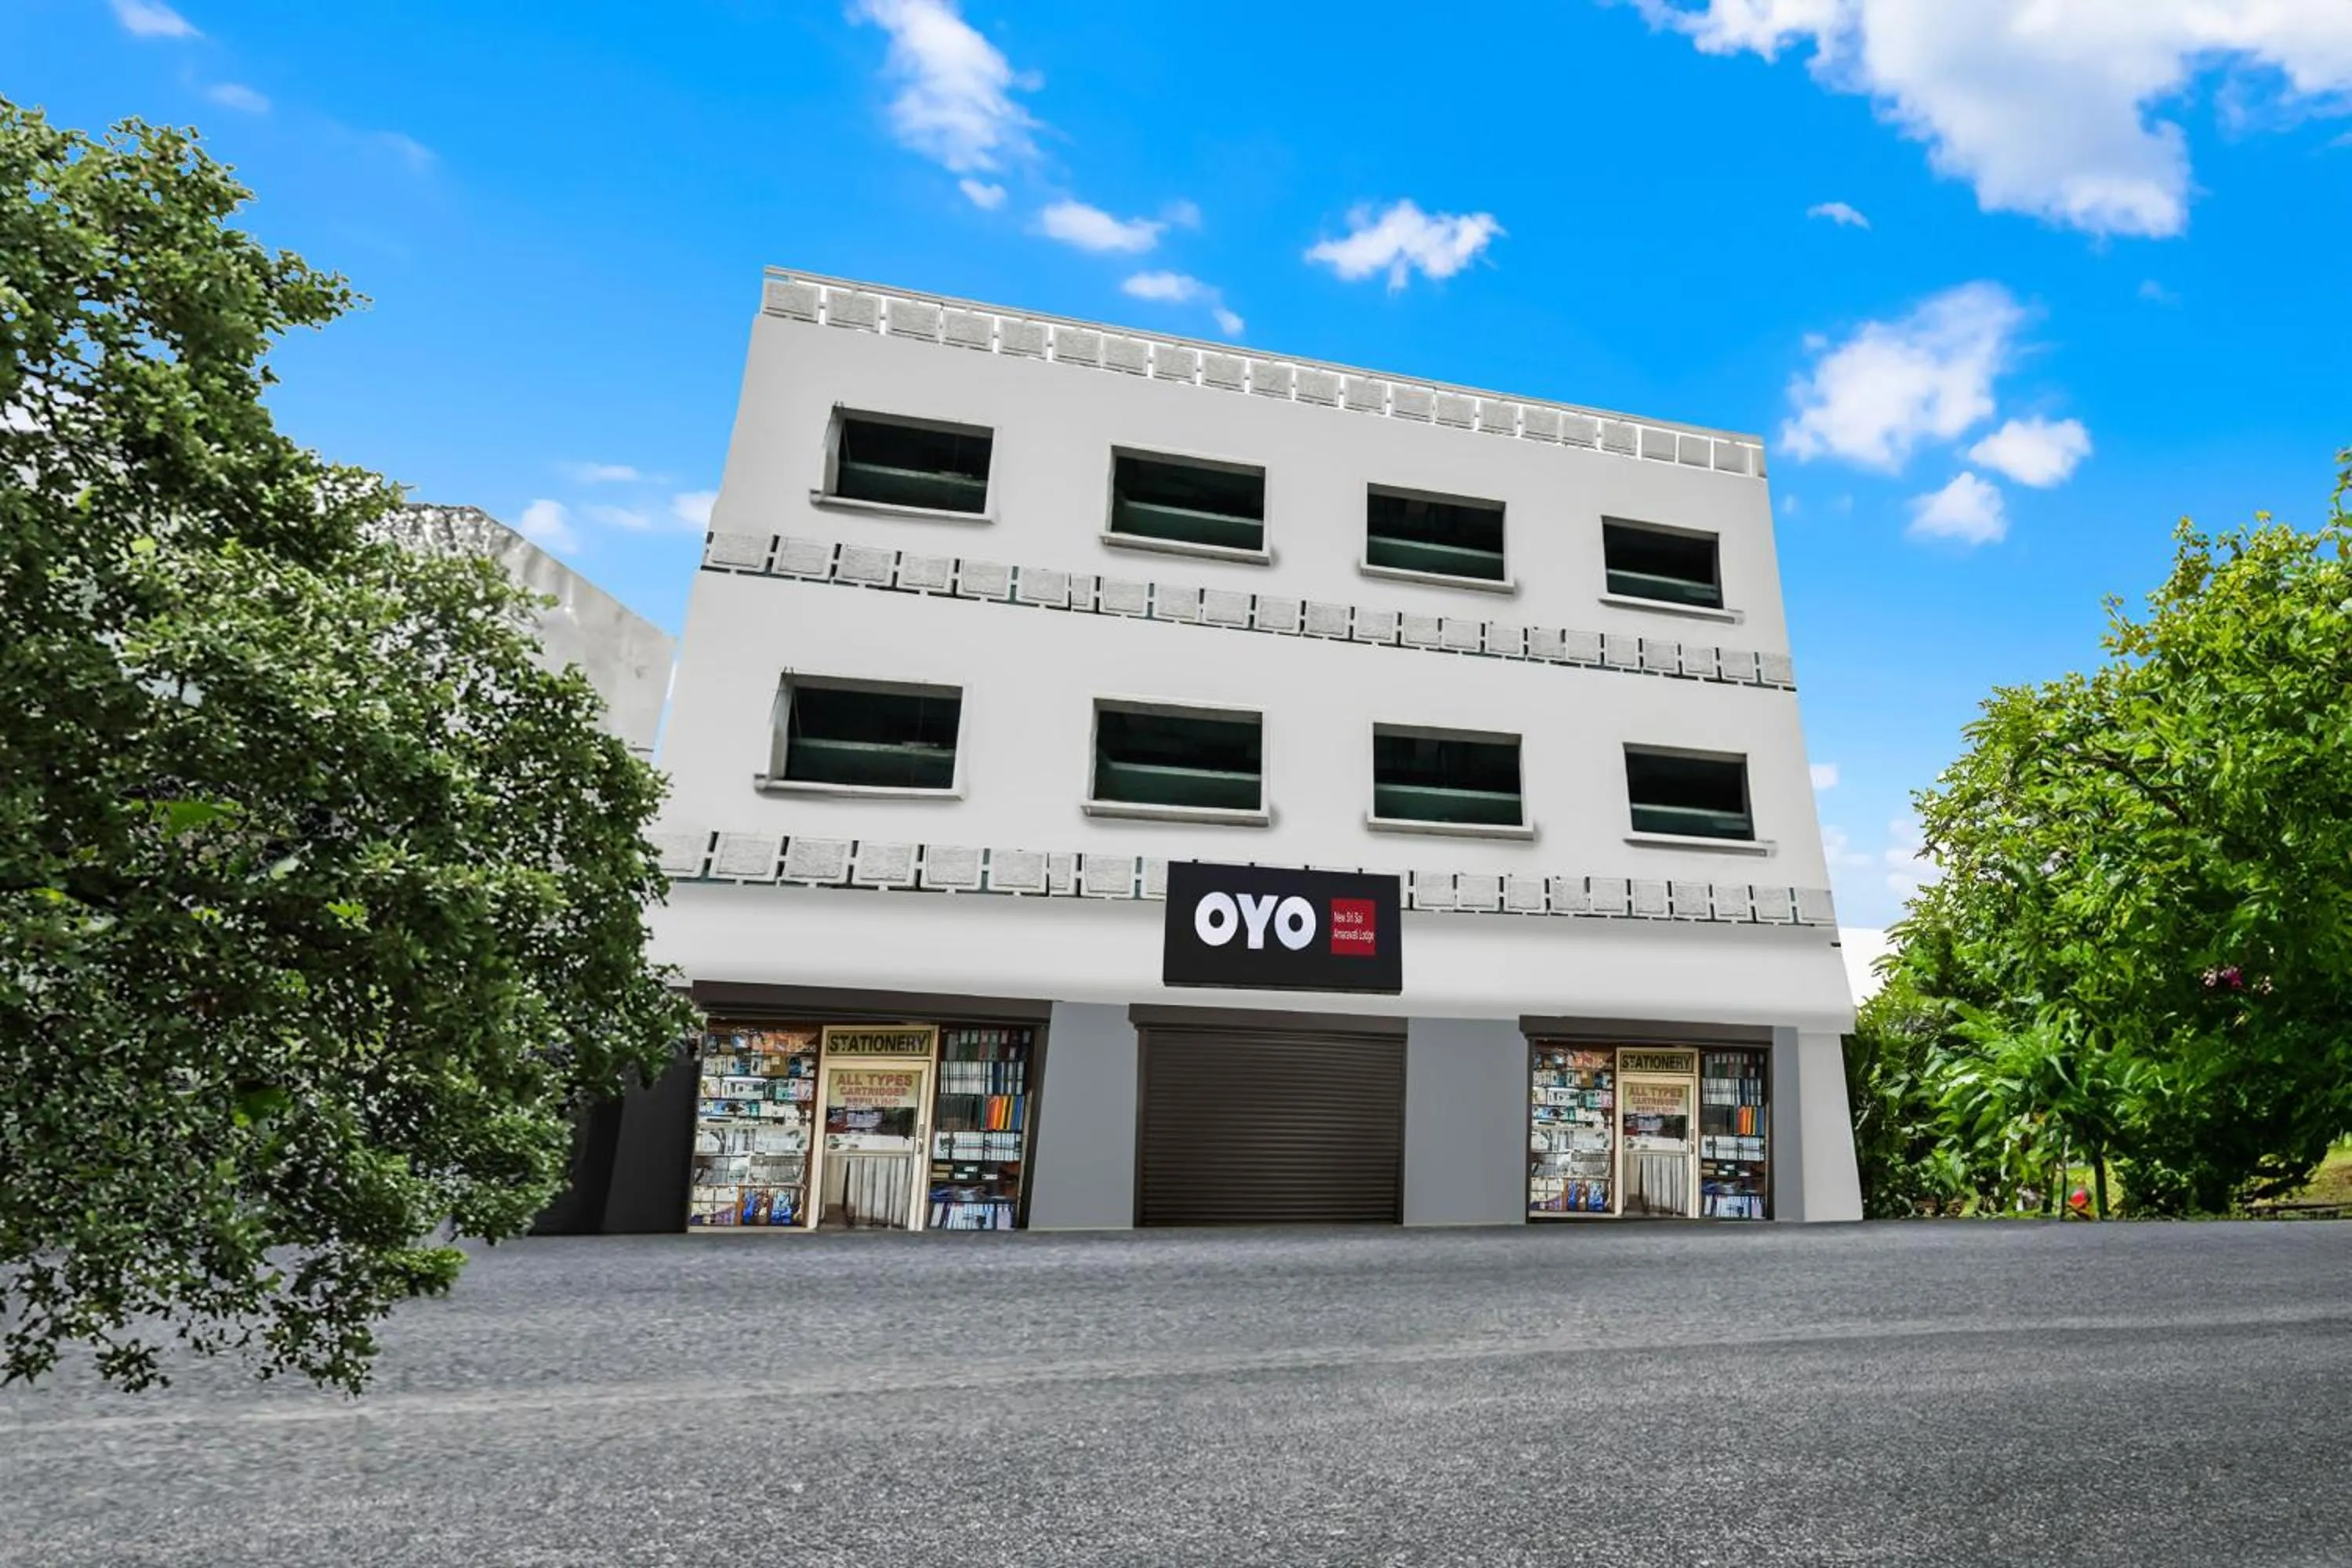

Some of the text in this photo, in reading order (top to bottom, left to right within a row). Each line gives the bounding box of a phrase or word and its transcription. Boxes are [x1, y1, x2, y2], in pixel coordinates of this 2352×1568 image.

[1195, 891, 1316, 950] OYO
[1334, 912, 1345, 922] New
[1359, 930, 1374, 943] Lodge
[829, 1035, 926, 1051] STATIONERY
[1622, 1055, 1690, 1069] STATIONERY
[837, 1073, 913, 1087] ALL TYPES
[1629, 1087, 1683, 1098] ALL TYPES
